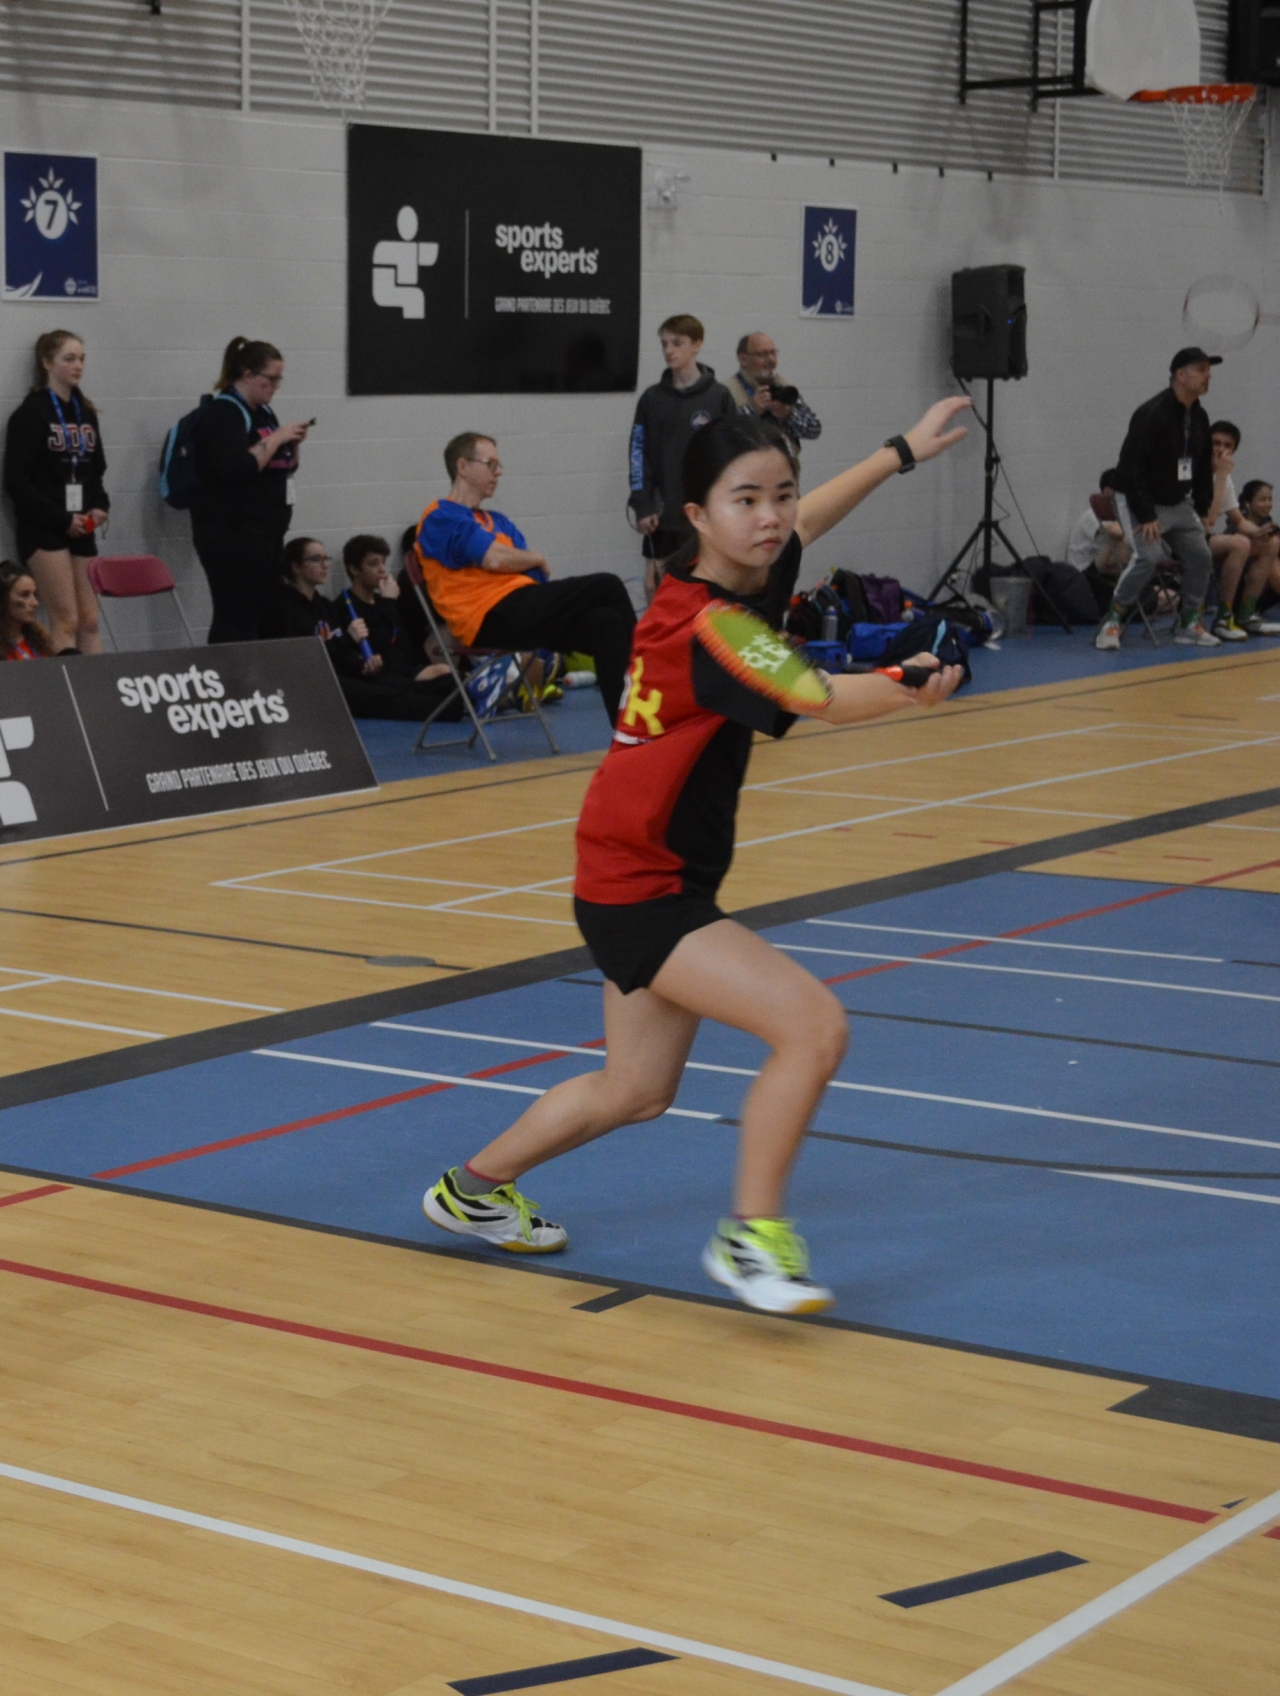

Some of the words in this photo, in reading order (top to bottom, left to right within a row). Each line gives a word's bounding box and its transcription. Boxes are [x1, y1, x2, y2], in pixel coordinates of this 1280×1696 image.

[44, 199, 59, 231] 7
[495, 222, 563, 254] sports
[825, 241, 834, 265] 8
[520, 247, 598, 279] experts
[117, 664, 225, 714] sports
[167, 688, 290, 739] experts
[146, 769, 183, 794] GRAND
[180, 761, 240, 789] PARTENAIRE
[236, 760, 262, 782] DES
[255, 757, 280, 780] JEUX
[279, 755, 296, 775] DU
[292, 749, 332, 774] QUÉBEC
